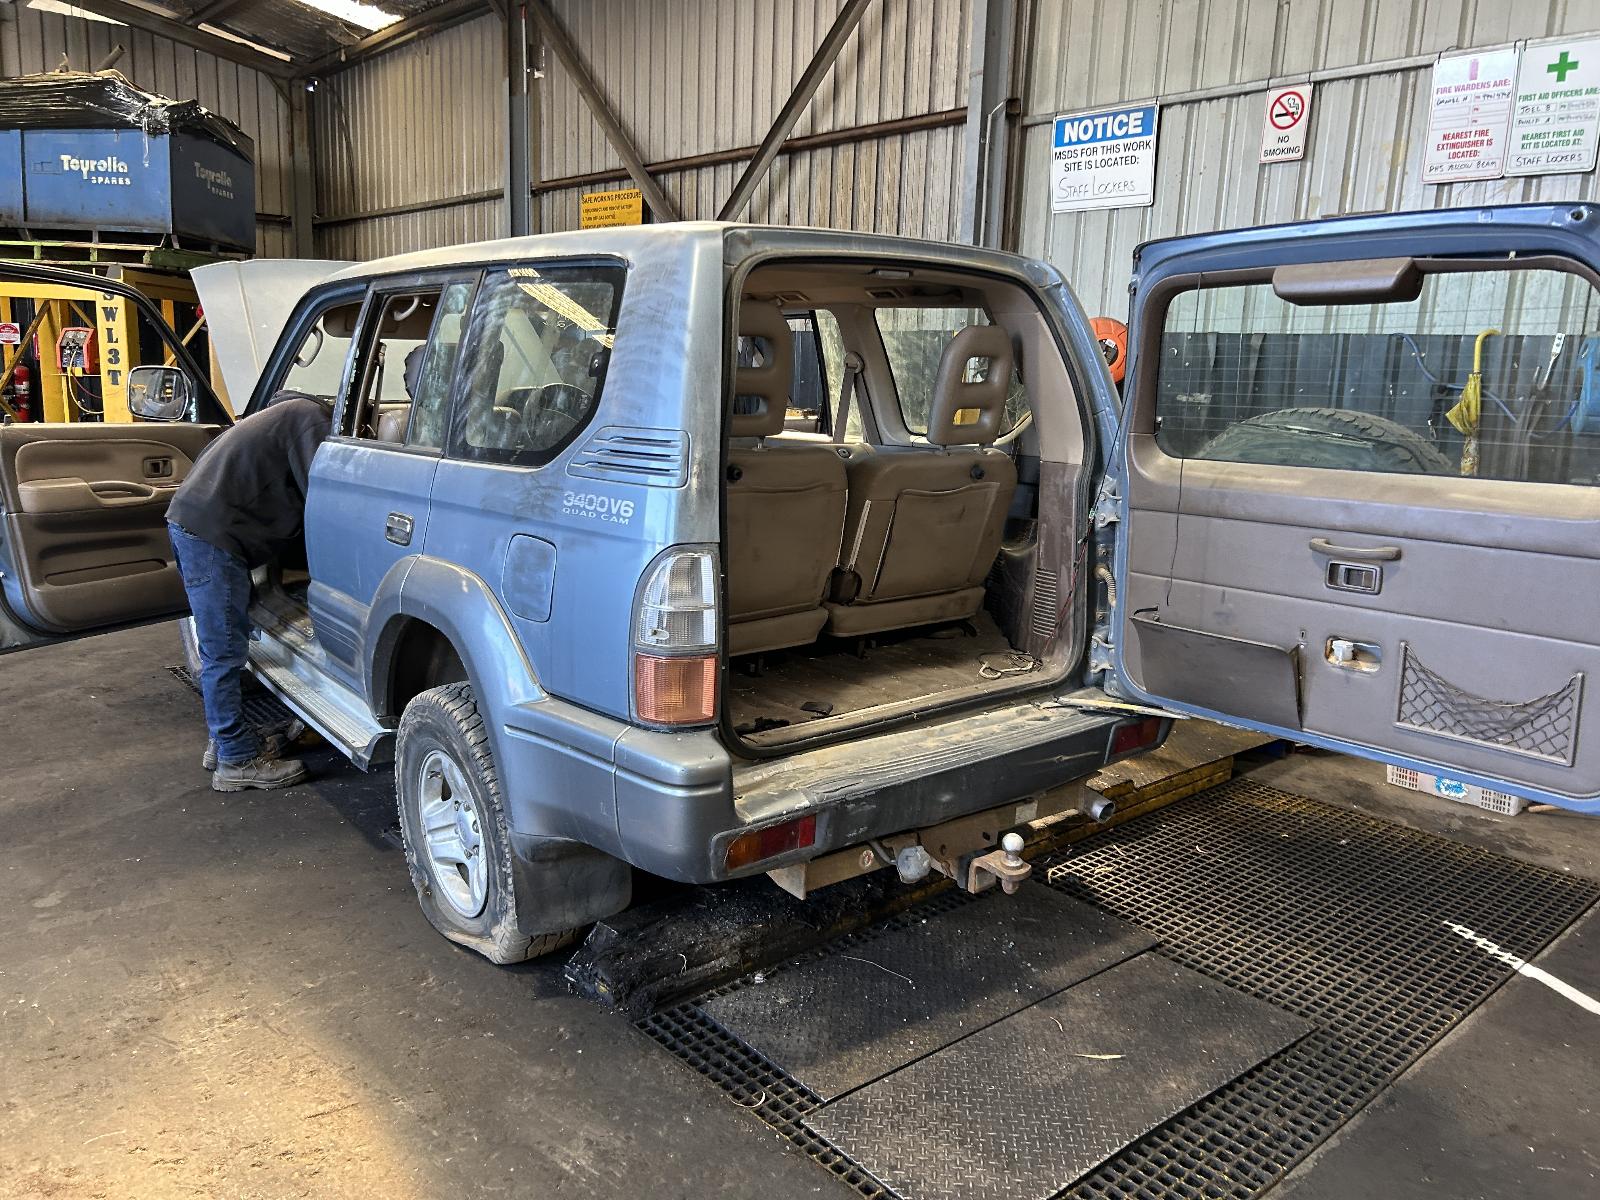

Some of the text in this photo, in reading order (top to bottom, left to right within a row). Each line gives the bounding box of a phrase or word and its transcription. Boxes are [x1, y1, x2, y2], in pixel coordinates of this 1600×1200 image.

[1436, 78, 1511, 96] FIRE WARDENS ARE:
[1518, 94, 1536, 102] FIRST
[1538, 92, 1550, 100] AID
[1551, 88, 1583, 99] OFFICERS
[1063, 112, 1144, 143] NOTICE
[1277, 135, 1290, 144] NO
[1442, 129, 1490, 141] NEAREST FIRE
[1522, 132, 1551, 140] NEAREST
[1552, 130, 1571, 138] FIRST
[1054, 140, 1152, 161] MSDS FOR THIS WORK
[1436, 138, 1493, 151] EXTINGUISHER IS
[1521, 142, 1532, 150] KIT
[1541, 140, 1571, 148] LOCATED
[1263, 146, 1301, 158] SMOKING
[1448, 150, 1480, 159] LOCATED:
[1064, 156, 1140, 172] SITE IS LOCATED:
[1516, 156, 1542, 166] STAFF
[91, 177, 131, 185] SPARES
[211, 187, 234, 199] SPARES
[1057, 176, 1135, 200] STAFF LOCKERS
[562, 507, 629, 525] QUAD CAM
